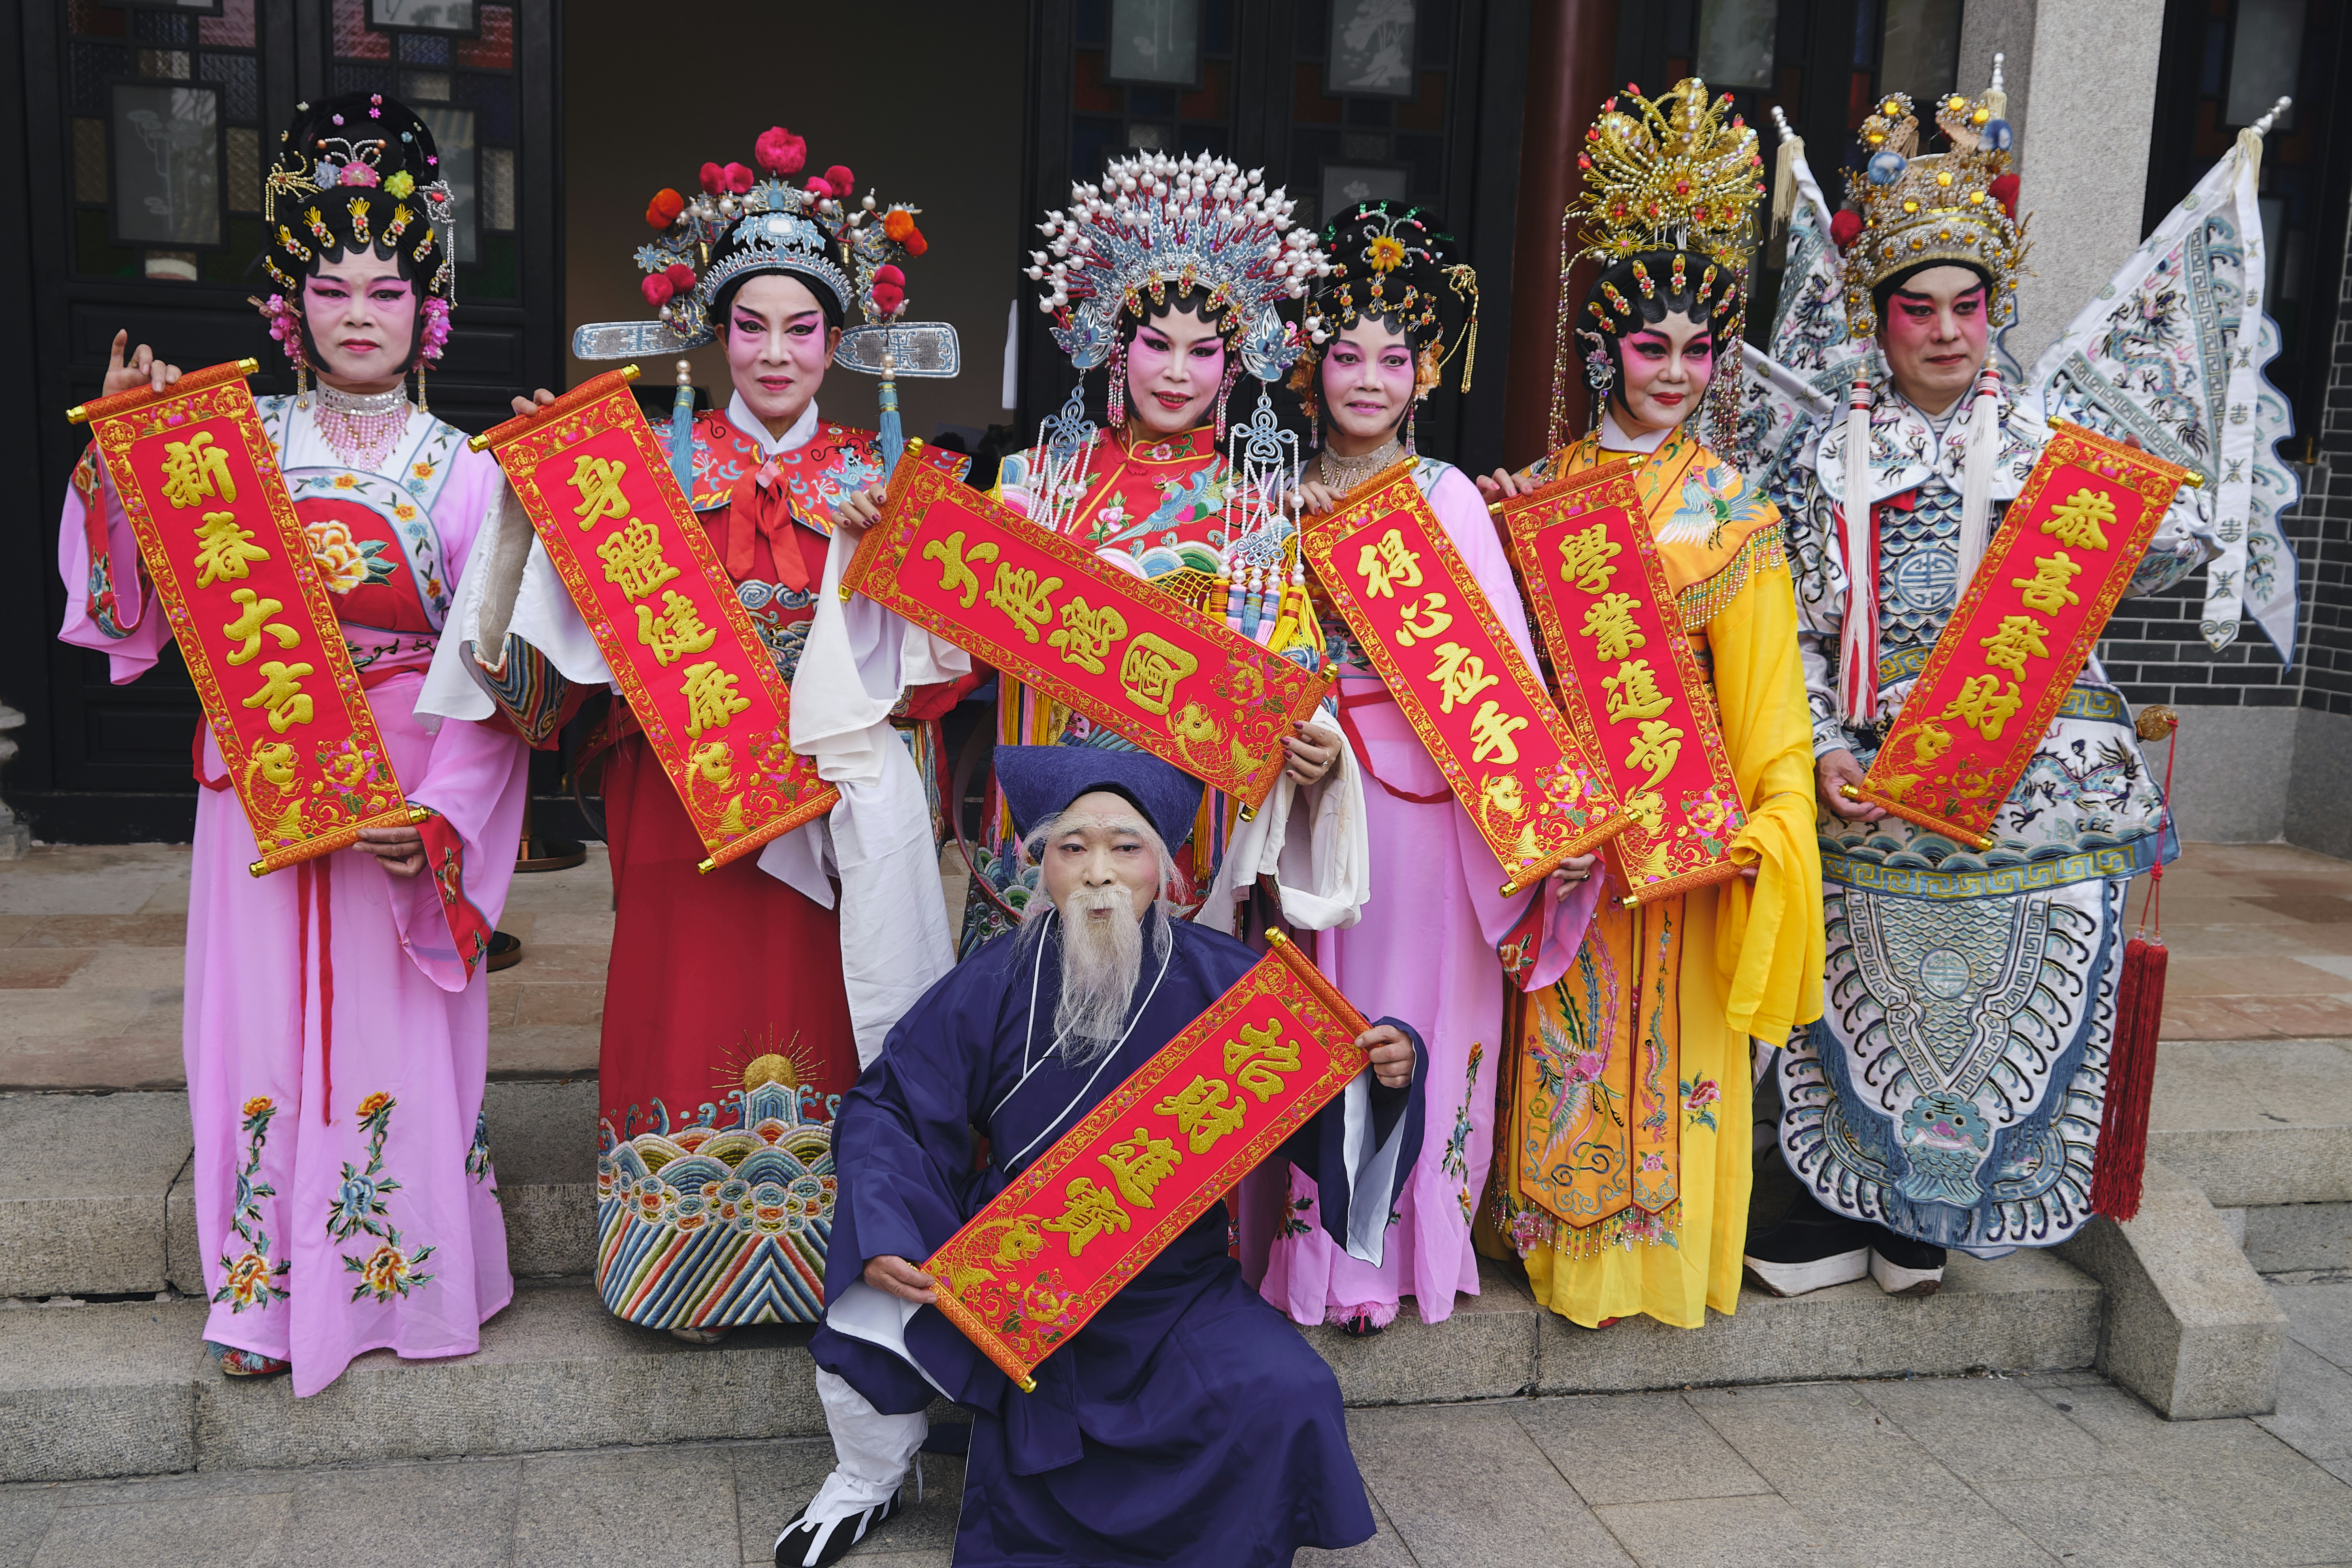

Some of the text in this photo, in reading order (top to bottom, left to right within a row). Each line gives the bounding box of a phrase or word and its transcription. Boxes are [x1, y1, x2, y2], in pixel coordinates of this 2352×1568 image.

[109, 426, 124, 442] 福
[2056, 443, 2071, 456] 福
[513, 451, 529, 467] 福
[279, 513, 294, 528] 福
[682, 516, 695, 531] 福
[1520, 518, 1532, 531] 福
[1035, 532, 1050, 546] 福
[1312, 537, 1325, 550] 福
[1993, 543, 2006, 556] 福
[150, 553, 165, 568] 福
[161, 431, 314, 734] 新春大吉
[569, 572, 584, 587] 福
[874, 576, 889, 590] 福
[1462, 579, 1475, 593] 福
[566, 455, 751, 740] 身體健康
[1136, 586, 1150, 599] 福
[1657, 589, 1670, 602] 福
[2101, 593, 2114, 606] 福
[1941, 487, 2117, 741] 恭喜發財
[320, 622, 335, 637] 福
[735, 616, 748, 631] 福
[922, 530, 1199, 716] 大展鴻圖
[1547, 626, 1560, 639] 福
[1364, 634, 1377, 648] 福
[1943, 635, 1956, 647] 福
[979, 642, 993, 656] 福
[1558, 523, 1684, 792] 學業進步
[194, 663, 208, 678] 福
[1515, 665, 1528, 679] 福
[624, 675, 638, 690] 福
[1689, 685, 1702, 699] 福
[2050, 685, 2064, 698] 福
[1077, 696, 1091, 709] 福
[1418, 718, 1431, 732] 福
[1578, 720, 1591, 733] 福
[1265, 969, 1280, 985] 福
[1161, 1053, 1177, 1068] 福
[1040, 1017, 1302, 1257] 招財進寶
[1073, 1132, 1088, 1147] 福
[1248, 1144, 1263, 1159] 福
[1161, 1223, 1176, 1237] 福
